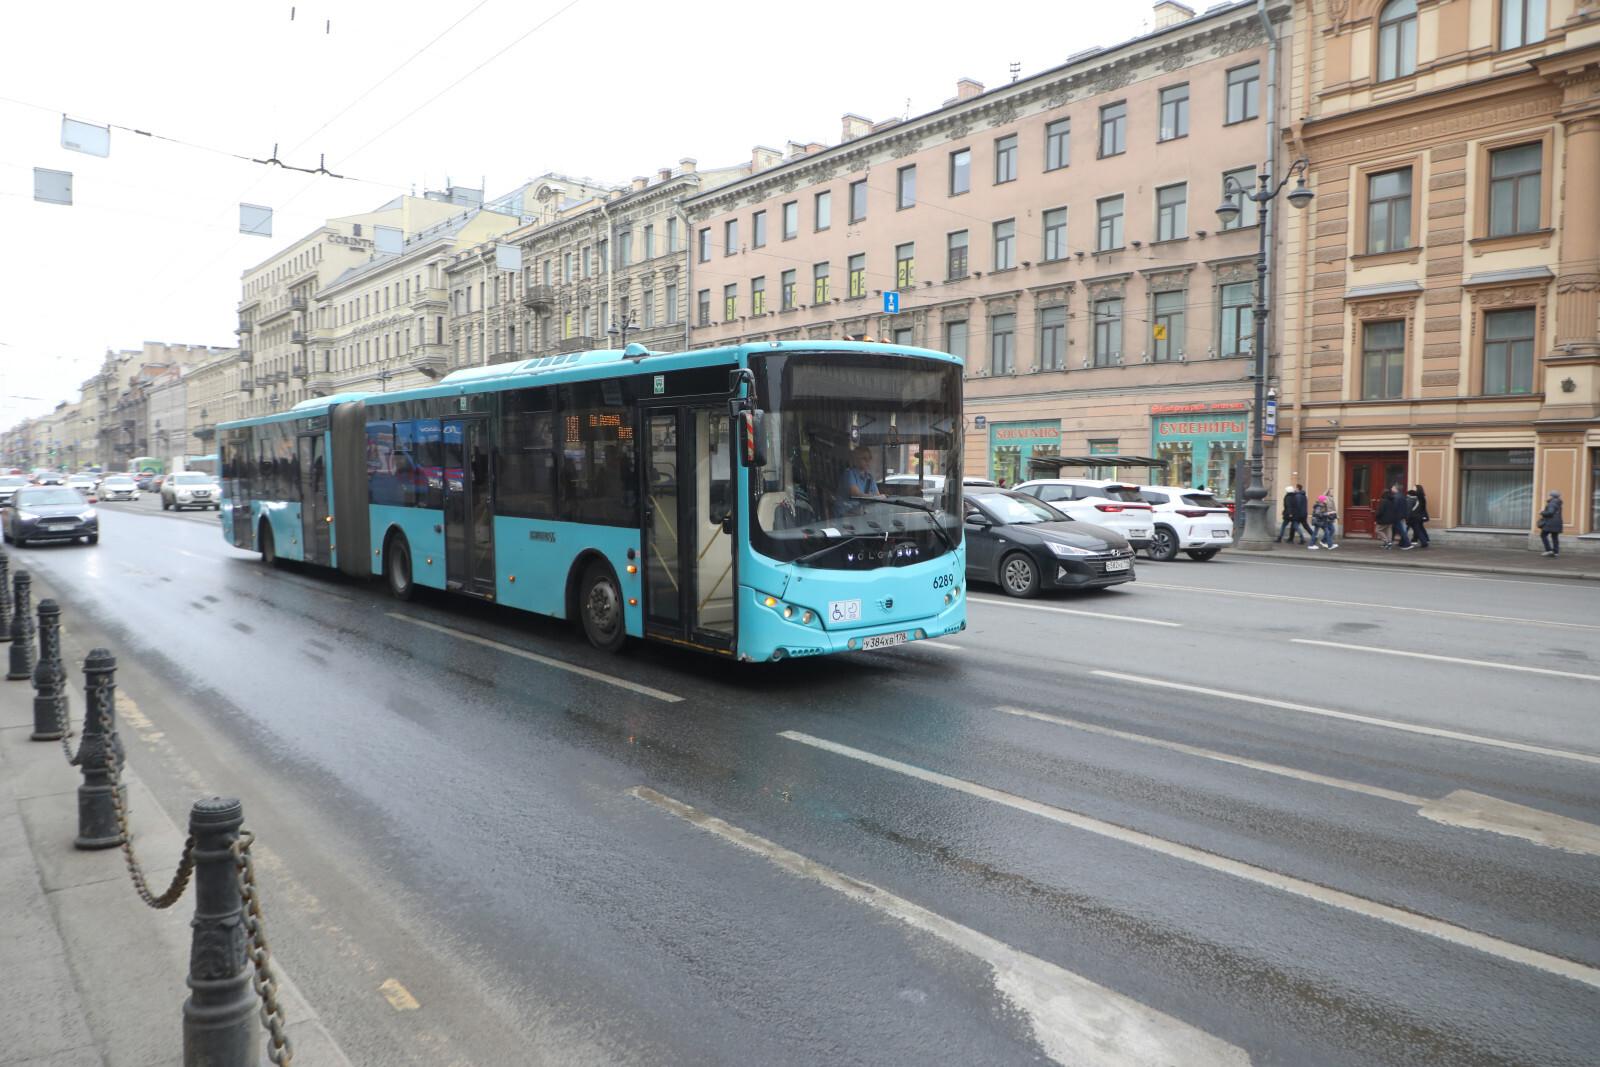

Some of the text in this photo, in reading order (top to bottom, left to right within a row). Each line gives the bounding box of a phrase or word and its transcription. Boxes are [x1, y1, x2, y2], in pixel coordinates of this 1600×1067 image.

[995, 426, 1059, 439] SOUVENIRS
[1159, 420, 1245, 435] СУВЕНИРЫ
[847, 548, 920, 561] VOLGABUS
[933, 573, 954, 590] 6289
